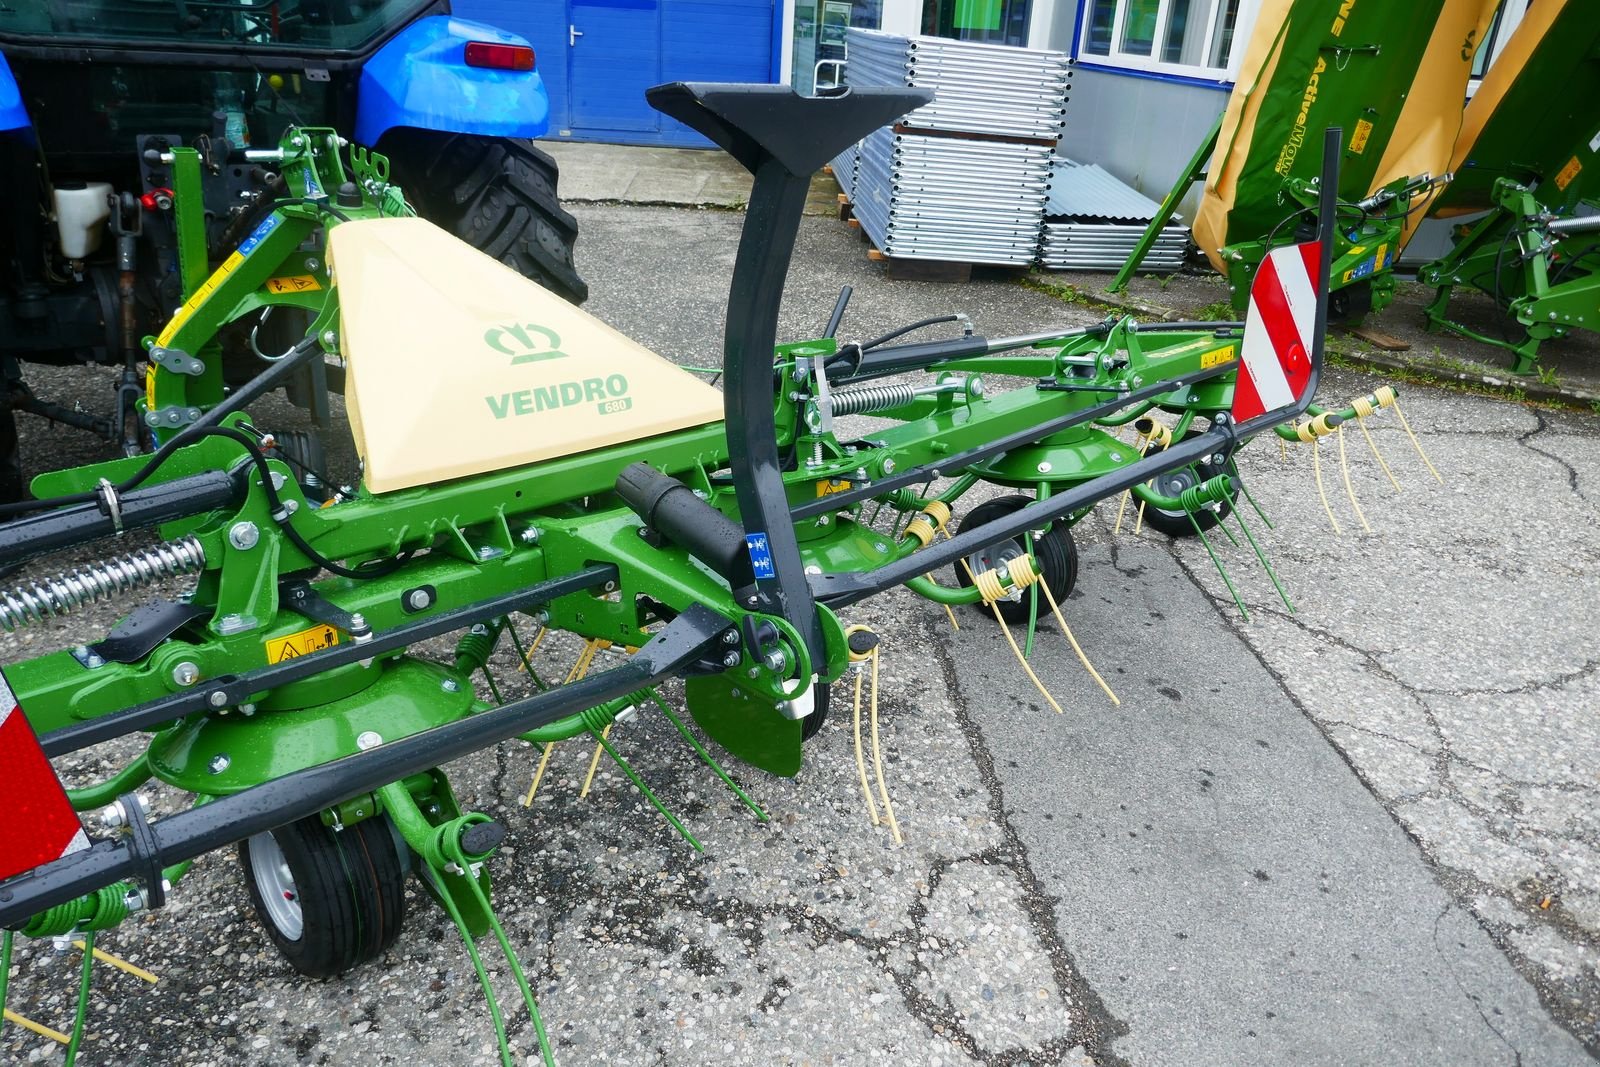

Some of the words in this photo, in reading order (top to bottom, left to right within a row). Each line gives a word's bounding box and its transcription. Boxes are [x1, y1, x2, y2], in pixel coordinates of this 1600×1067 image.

[1280, 56, 1327, 177] ActiveMow
[485, 374, 628, 419] VENDRO
[604, 400, 627, 413] 680
